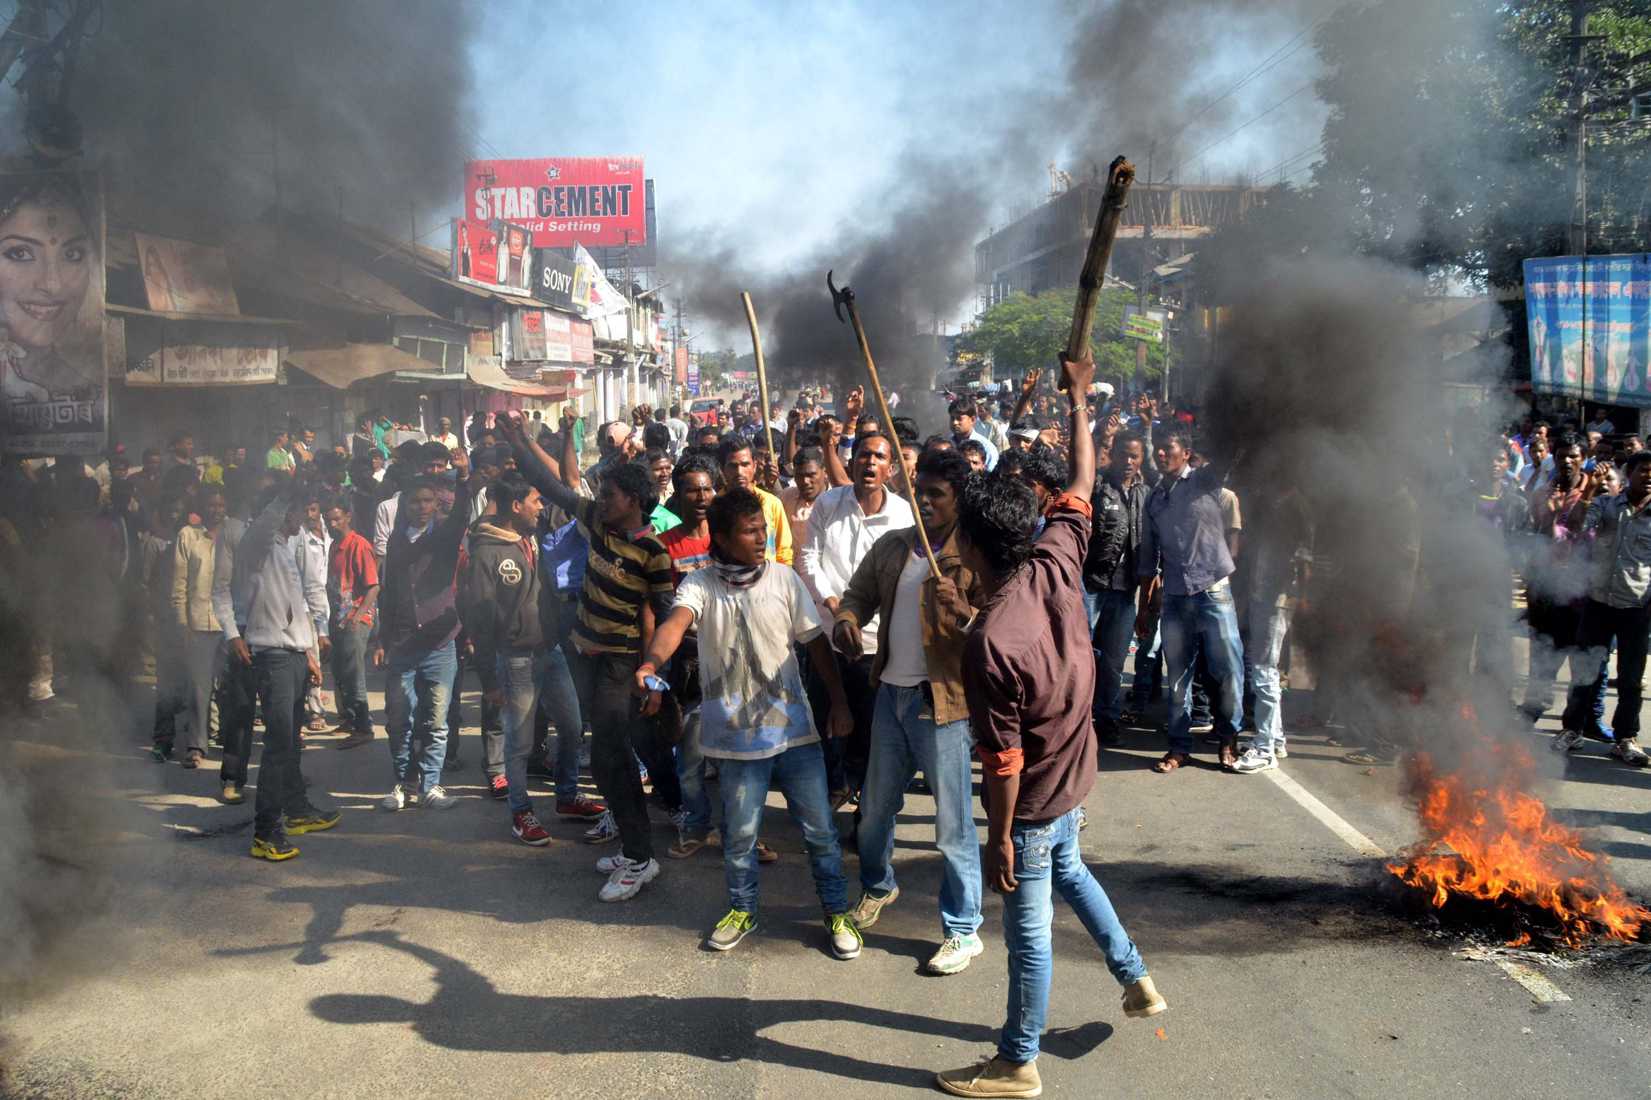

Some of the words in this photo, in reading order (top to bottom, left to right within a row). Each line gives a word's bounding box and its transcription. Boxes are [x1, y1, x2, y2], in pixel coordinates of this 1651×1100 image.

[511, 222, 544, 232] lid
[548, 221, 601, 232] Setting
[543, 266, 572, 293] SONY
